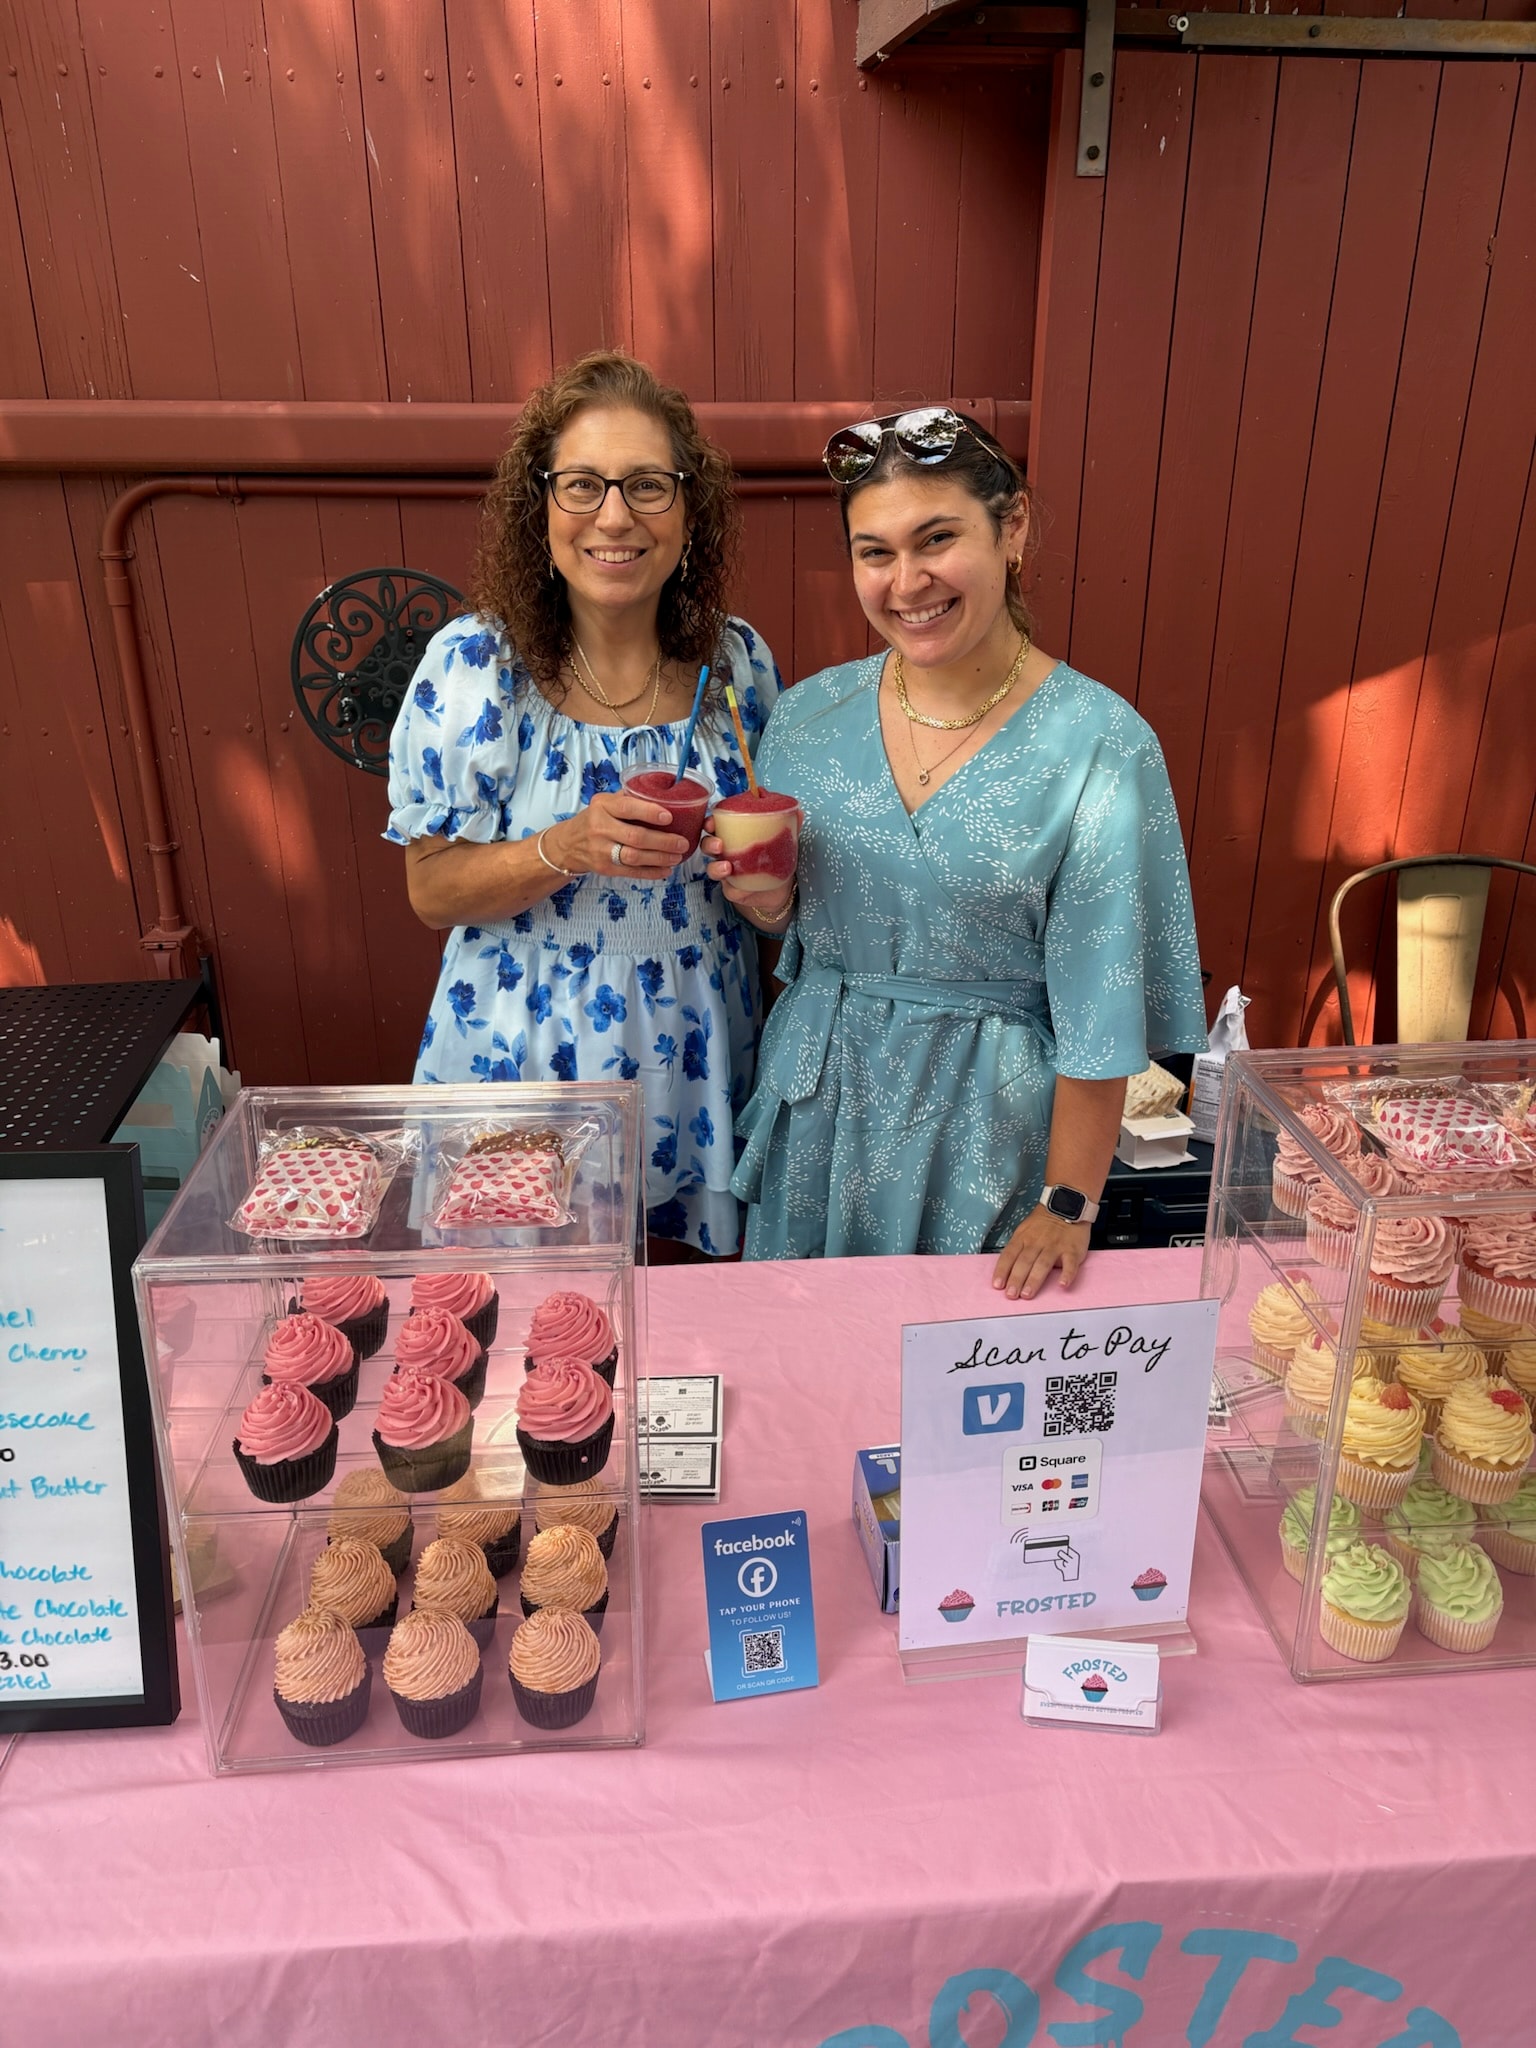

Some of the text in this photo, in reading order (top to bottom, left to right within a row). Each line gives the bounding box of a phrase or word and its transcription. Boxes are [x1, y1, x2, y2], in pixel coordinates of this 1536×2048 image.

[8, 1343, 88, 1373] Cherry
[947, 1326, 1173, 1374] Scan to Pay
[1040, 1455, 1086, 1468] Square
[31, 1476, 108, 1499] Butter
[1011, 1483, 1034, 1492] VISA
[714, 1529, 796, 1557] facebook
[34, 1598, 128, 1619] Chocolate
[719, 1597, 801, 1617] TAP YOUR PHONE
[996, 1591, 1097, 1617] FROSTED
[731, 1611, 792, 1626] TO FOLLOW US!
[21, 1627, 112, 1646] Chocolate
[1062, 1659, 1128, 1682] FROSTED
[747, 1681, 765, 1689] SCAN
[765, 1679, 776, 1687] QR
[777, 1676, 795, 1685] CODE
[818, 1921, 1462, 2048] OSTE
